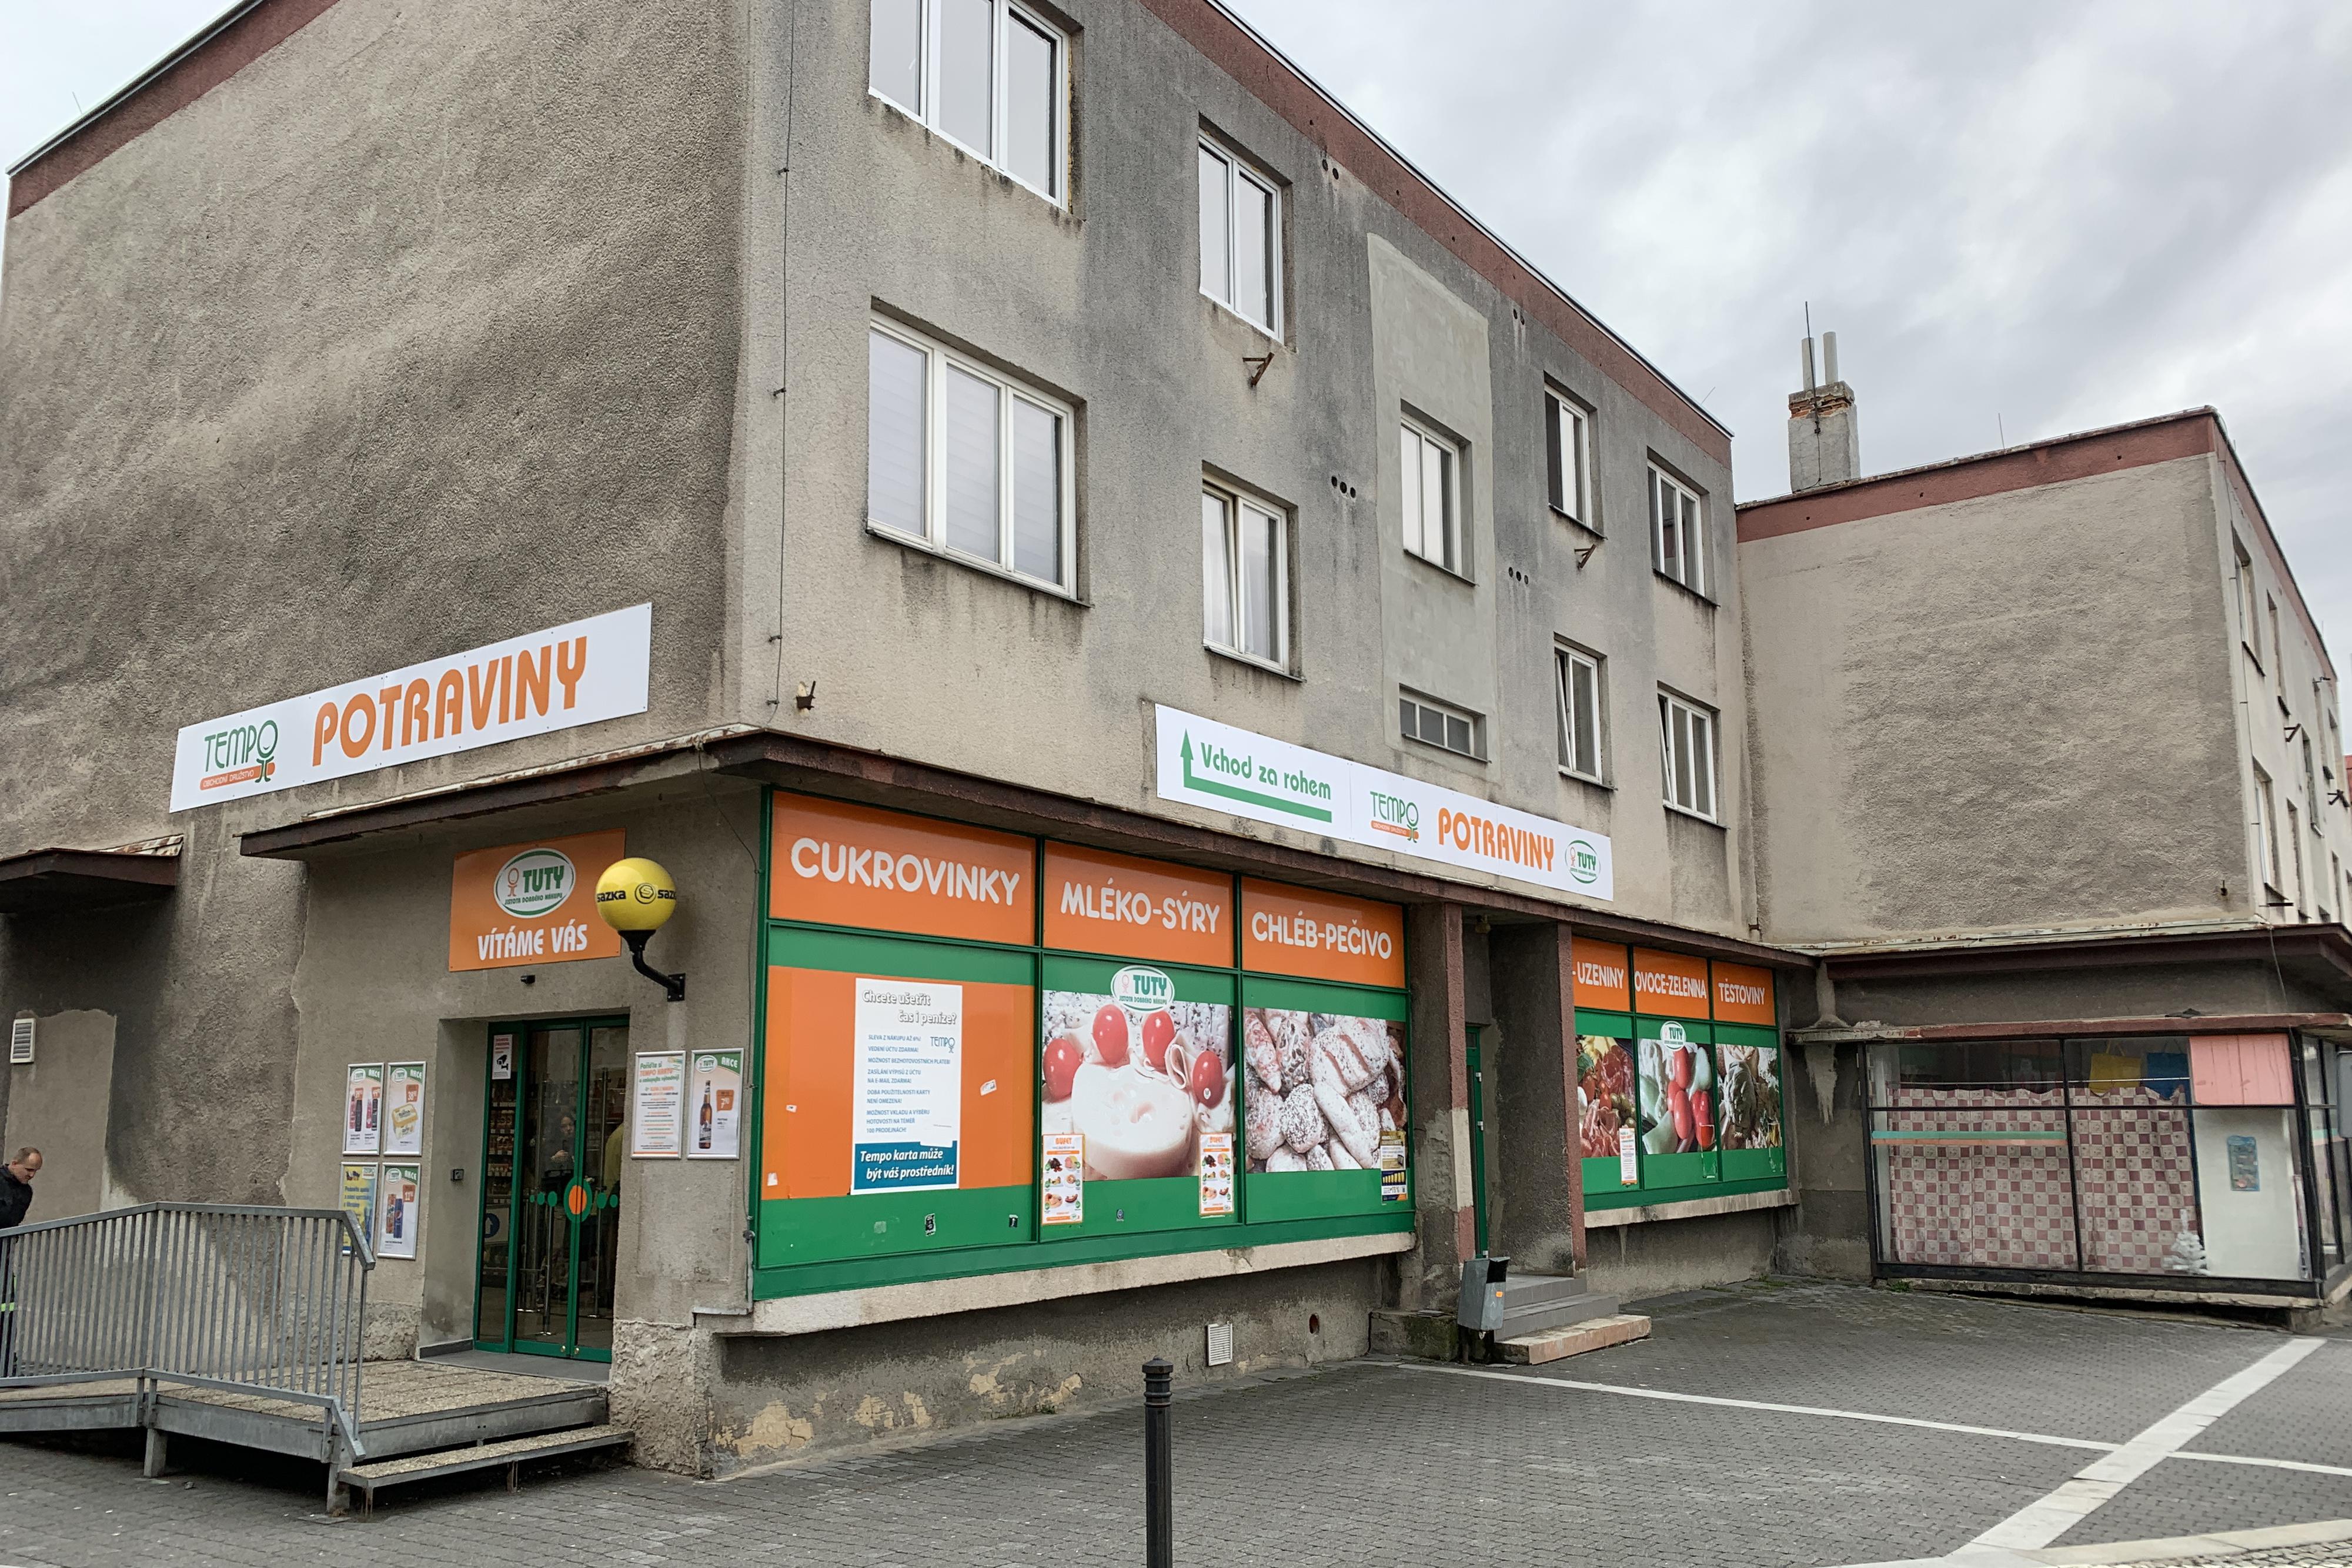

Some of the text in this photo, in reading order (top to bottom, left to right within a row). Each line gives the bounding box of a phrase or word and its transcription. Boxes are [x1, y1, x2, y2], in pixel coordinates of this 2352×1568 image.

[312, 636, 587, 767] POTRAVINY
[204, 720, 278, 772] TEMPO
[1200, 742, 1332, 801] Vchod za rohem
[1369, 791, 1419, 827] TEMPO
[1438, 807, 1555, 873] POTRAVINY
[791, 837, 1020, 905] CUKROVINKY
[1577, 851, 1596, 871] TUTY
[523, 865, 564, 893] TUTY
[1060, 877, 1220, 934] MLÉKO-SÝRY
[477, 919, 588, 961] VÍTÁME VÁS
[1251, 910, 1392, 959] CHLÉB-PEČIVO
[862, 990, 931, 1006] Chcete ušetřit
[1133, 974, 1167, 997] TUTY
[1634, 971, 1707, 999] OVOCE-ZELENINA
[898, 1009, 957, 1026] čas i peníze?
[930, 1037, 956, 1047] TEMPO
[1669, 1027, 1682, 1039] TUTY
[860, 1148, 944, 1164] Tempo karta může
[866, 1165, 955, 1182] být váš prostředník!
